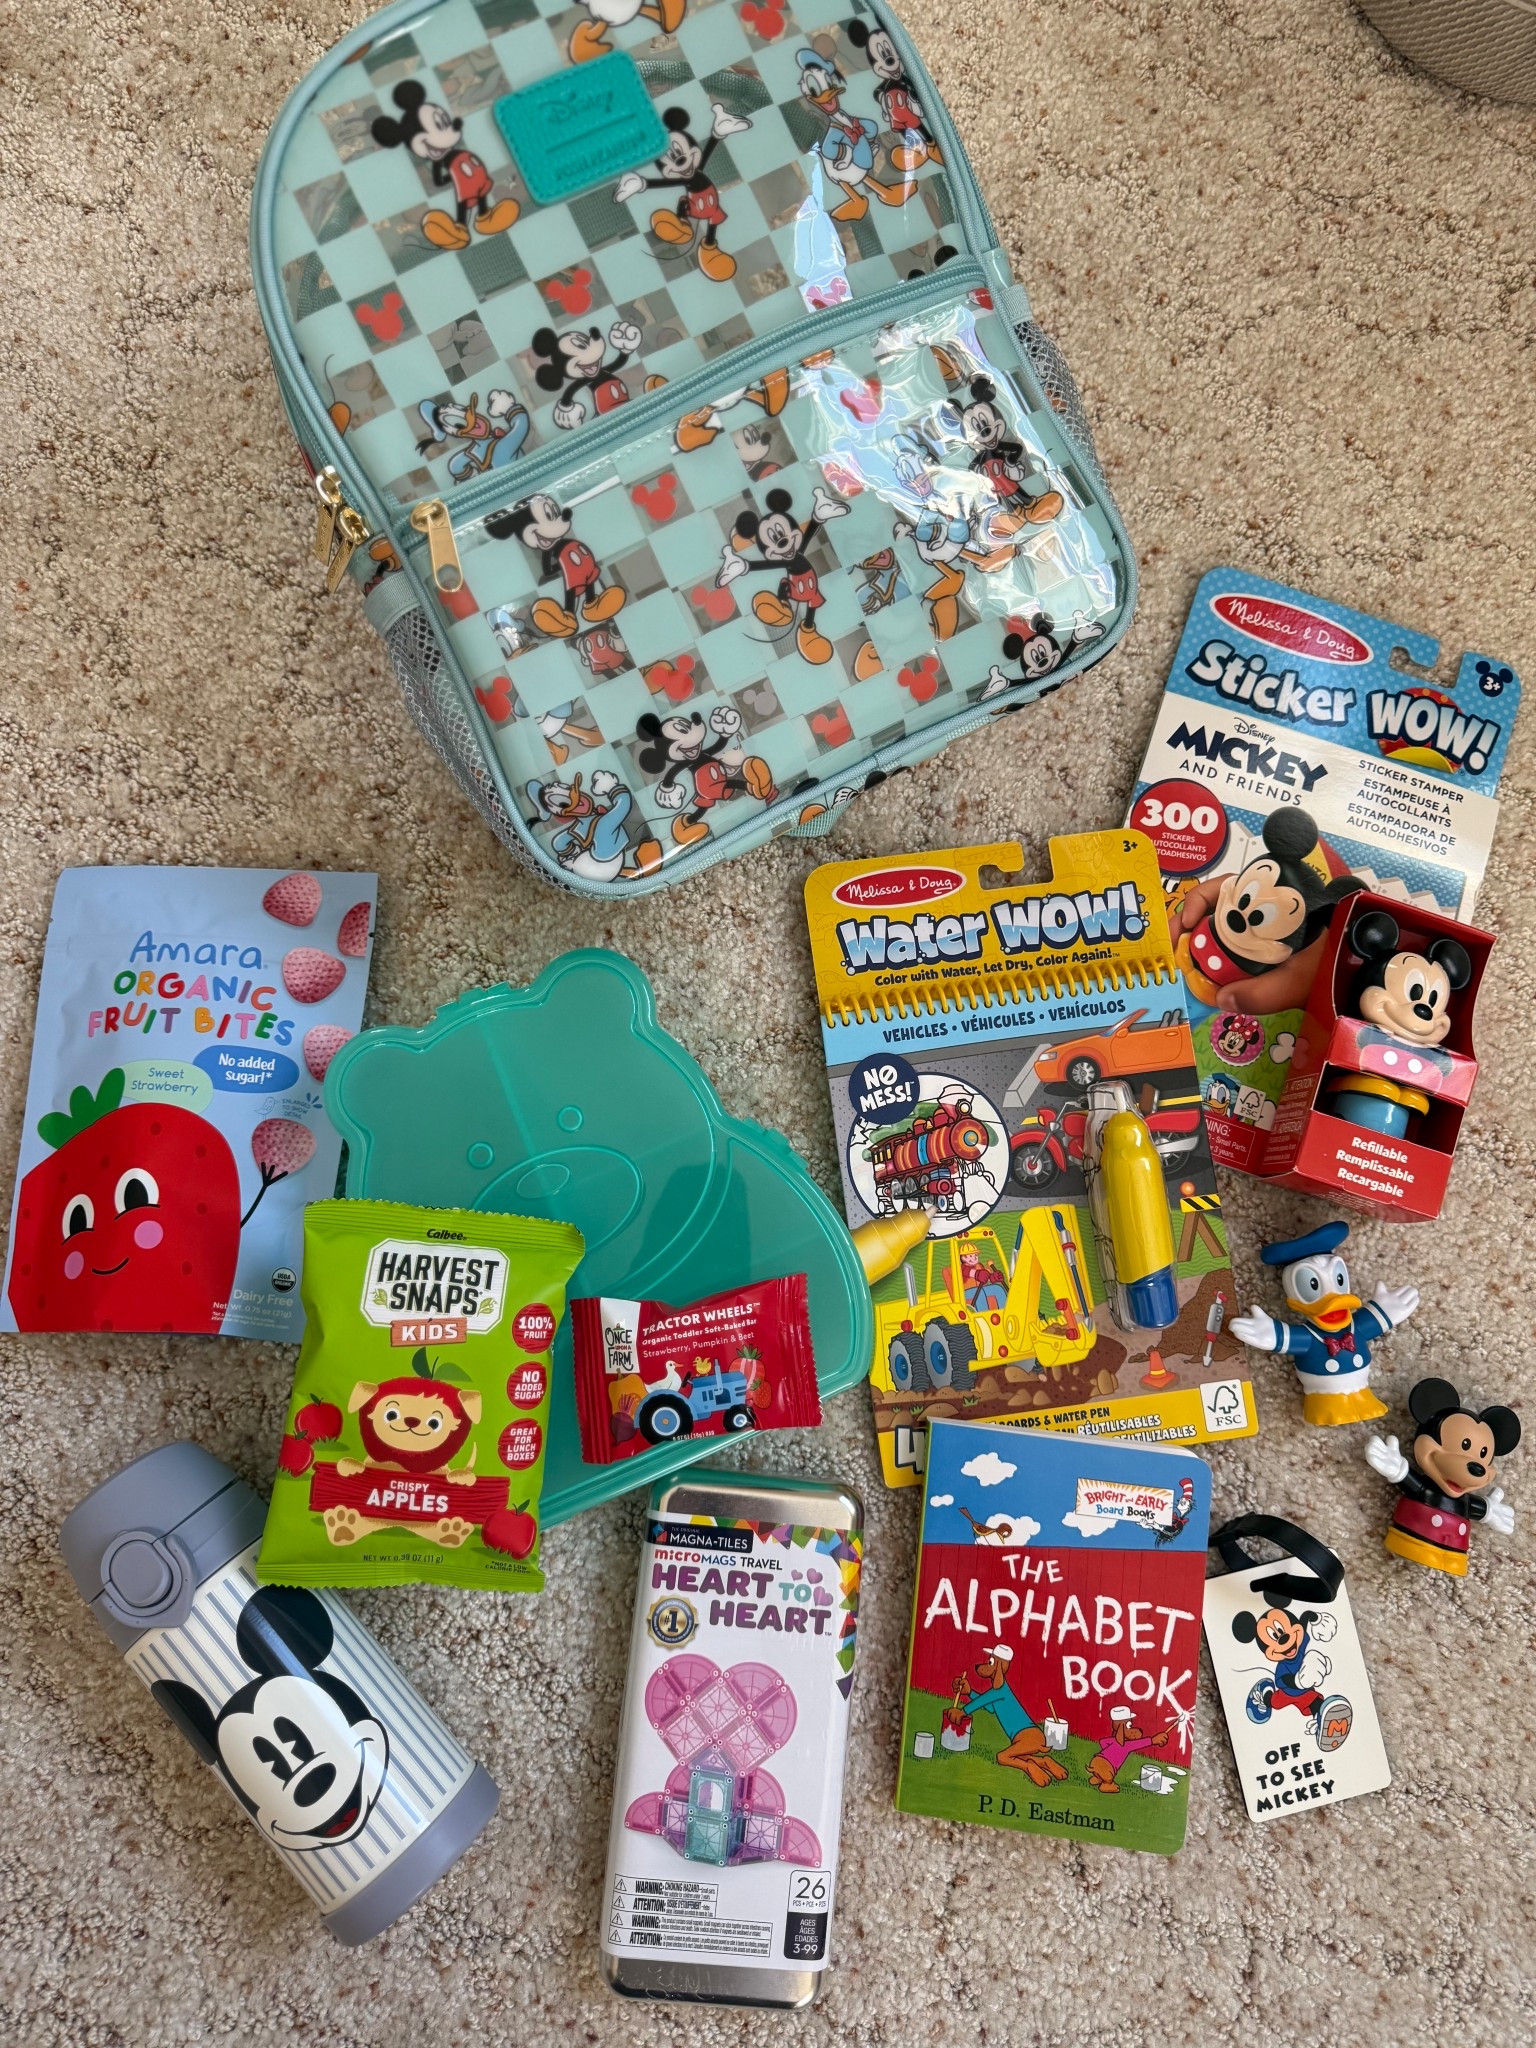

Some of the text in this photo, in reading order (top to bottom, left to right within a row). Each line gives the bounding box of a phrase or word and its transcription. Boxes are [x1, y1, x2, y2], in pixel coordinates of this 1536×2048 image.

[539, 91, 613, 124] Disney
[1228, 599, 1356, 660] Melissa & Doug
[1484, 676, 1501, 690] 3+
[1187, 640, 1501, 776] Sticker WOW!
[1166, 721, 1328, 792] MICKEY
[1179, 759, 1302, 806] AND FRIENDS
[1358, 759, 1464, 803] STICKER STAMPER
[1363, 778, 1450, 815] ESTAMPEUSE À
[1140, 798, 1219, 834] 300
[1357, 789, 1452, 828] AUTOCOLLANTS
[1347, 802, 1456, 846] ESTAMPADORA DE
[1123, 840, 1138, 852] 3+
[1153, 840, 1207, 853] UTOCOLLANTS
[1162, 832, 1195, 843] STICKERS
[1346, 816, 1447, 856] AUTOADHESIVOS
[1157, 848, 1207, 862] TOADHESIVOS
[846, 876, 953, 902] Melissa & Doug
[839, 883, 1145, 974] Water WOW!
[129, 930, 262, 970] Amara
[874, 976, 908, 987] Color
[910, 969, 938, 982] with
[941, 965, 982, 979] Water,
[983, 962, 1003, 973] Let
[1005, 958, 1033, 972] Dry,
[1035, 954, 1068, 967] Color
[113, 970, 277, 1011] ORGANIC
[88, 1001, 295, 1046] FRUIT BITES
[883, 999, 1126, 1043] VEHICLES VÉHICULES VEHÍCULOS
[148, 1067, 184, 1079] Sweet
[218, 1053, 275, 1071] No added
[131, 1079, 198, 1096] Strawberry
[863, 1065, 898, 1088] NO
[859, 1082, 913, 1113] MESS!
[1240, 1107, 1258, 1119] FSC
[1205, 1118, 1231, 1136] NING:
[1214, 1145, 1235, 1158] 3 years.
[1216, 1136, 1231, 1147] Small
[1232, 1141, 1247, 1152] Parts.
[1352, 1136, 1408, 1164] Refillable
[1336, 1150, 1415, 1183] Remplissable
[1337, 1168, 1404, 1198] Recargable
[426, 1228, 464, 1241] Calbee
[377, 1251, 500, 1290] HARVEST
[213, 1302, 227, 1310] Net
[233, 1289, 294, 1307] Dairy Free
[389, 1282, 480, 1316] SNAPS
[401, 1323, 458, 1341] KIDS
[518, 1316, 553, 1330] 100%
[642, 1334, 672, 1346] Organic
[673, 1329, 703, 1340] Toddler
[704, 1320, 745, 1334] Soft-Baked
[643, 1313, 701, 1336] TRACTOR
[523, 1330, 547, 1340] FRUIT
[605, 1327, 632, 1346] ONCE
[643, 1344, 691, 1358] Strawberry,
[693, 1337, 728, 1349] Pumpkin
[738, 1332, 755, 1341] Beet
[608, 1347, 634, 1371] FARM
[515, 1383, 543, 1392] ADDED
[522, 1371, 540, 1383] NO
[1044, 1415, 1051, 1426] &
[1053, 1409, 1088, 1424] WATER
[1090, 1407, 1110, 1419] PEN
[1077, 1414, 1162, 1436] RÉUTILISABLES
[1216, 1414, 1242, 1427] FSC
[510, 1427, 537, 1436] GREAT
[514, 1436, 531, 1445] FOR
[507, 1443, 536, 1453] LUNCH
[507, 1452, 535, 1461] BOXES
[390, 1480, 429, 1493] CRISPY
[366, 1489, 449, 1513] APPLES
[1084, 1490, 1126, 1505] BRIGHT
[1134, 1494, 1168, 1511] EARLY
[1096, 1504, 1124, 1516] Board
[669, 1532, 748, 1549] MAGNA-TILES
[363, 1554, 377, 1562] NET
[412, 1554, 422, 1562] OZ
[654, 1549, 783, 1571] microMAGS TRAVEL
[1002, 1553, 1063, 1583] THE
[651, 1563, 812, 1603] HEART TO
[664, 1610, 679, 1633] #1
[923, 1577, 1195, 1657] ALPHABET
[1062, 1655, 1193, 1715] BOOK
[1264, 1743, 1301, 1766] OFF
[1256, 1759, 1326, 1790] TO SEE
[1256, 1779, 1335, 1813] MICKEY
[977, 1794, 1116, 1832] P. D. Eastman
[635, 1880, 664, 1895] WARNING:
[795, 1876, 825, 1900] 26
[632, 1897, 666, 1912] ATTENTION:
[631, 1914, 661, 1929] WARNING:
[799, 1919, 816, 1927] AGES
[629, 1931, 662, 1946] ATTENTION:
[793, 1943, 818, 1955] 3-99
[794, 1935, 818, 1943] EDADES
